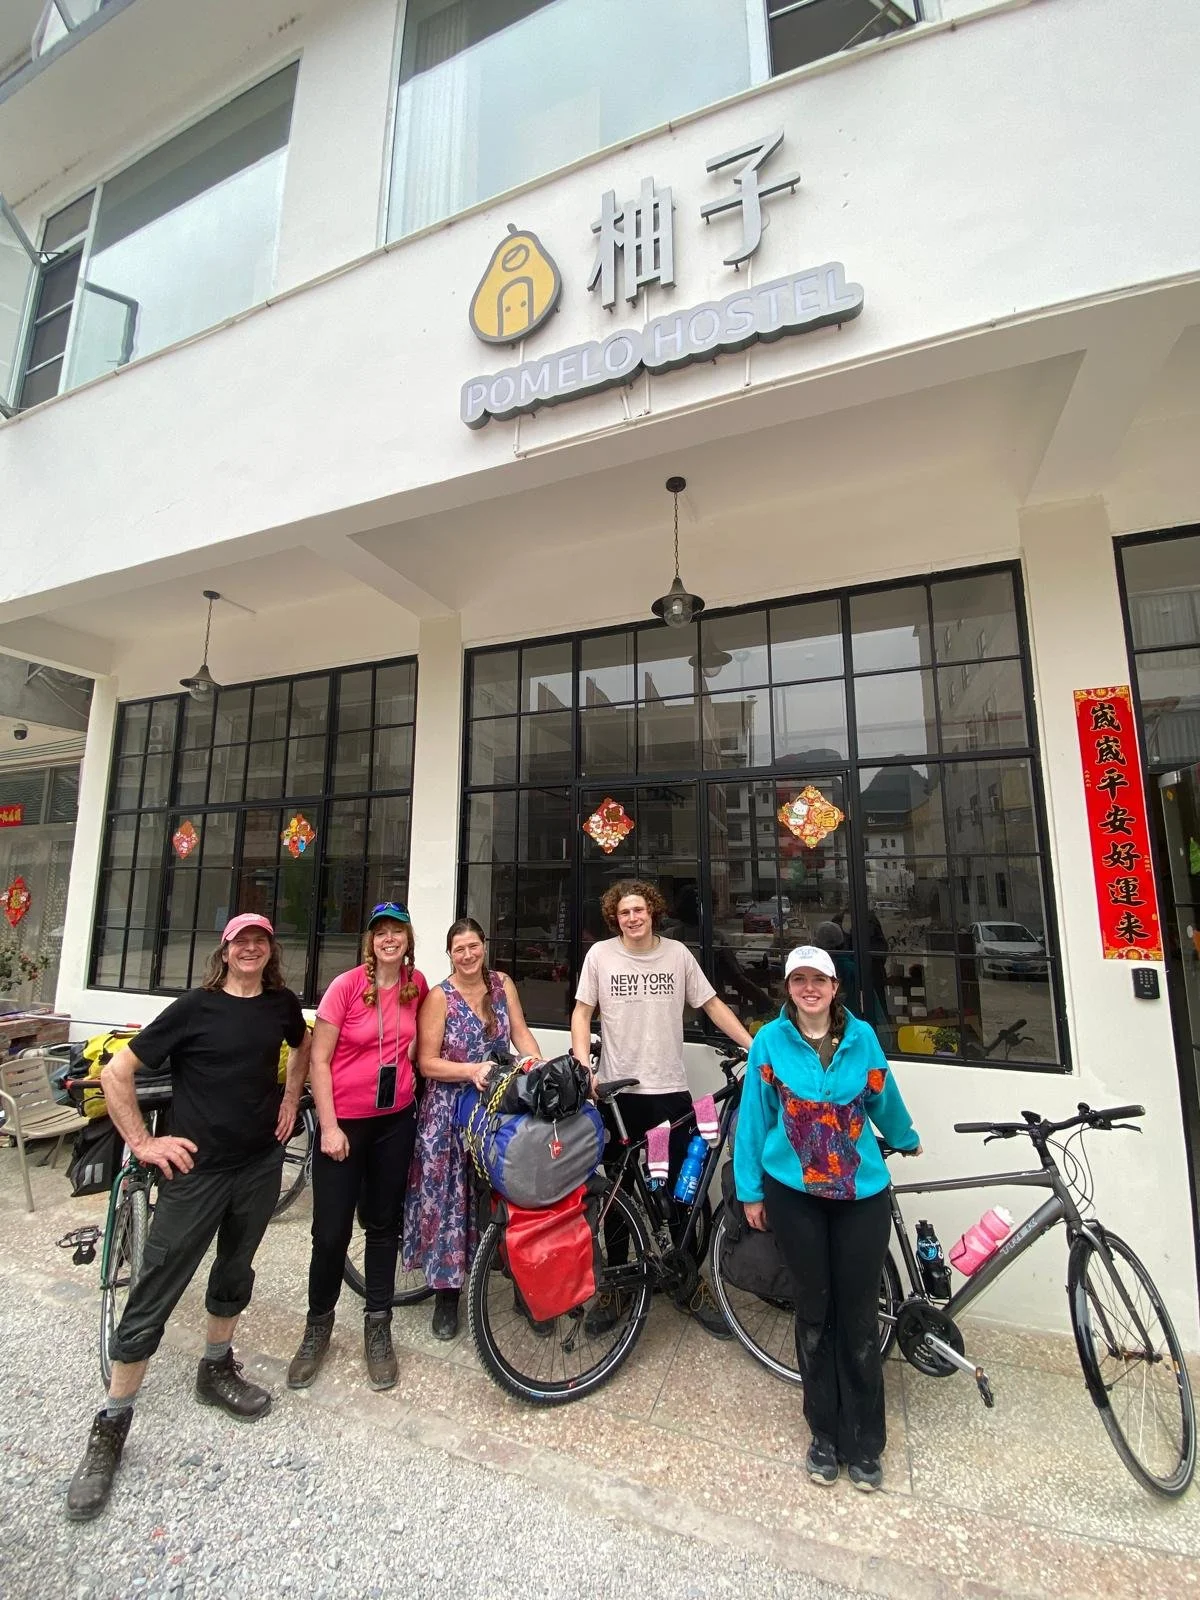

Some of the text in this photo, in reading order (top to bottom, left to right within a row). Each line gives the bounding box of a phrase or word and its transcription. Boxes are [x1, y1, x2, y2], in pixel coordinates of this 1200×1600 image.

[587, 125, 801, 310] 柚子
[465, 267, 857, 417] POMELO HOSTEL
[610, 973, 675, 985] NEW YORK
